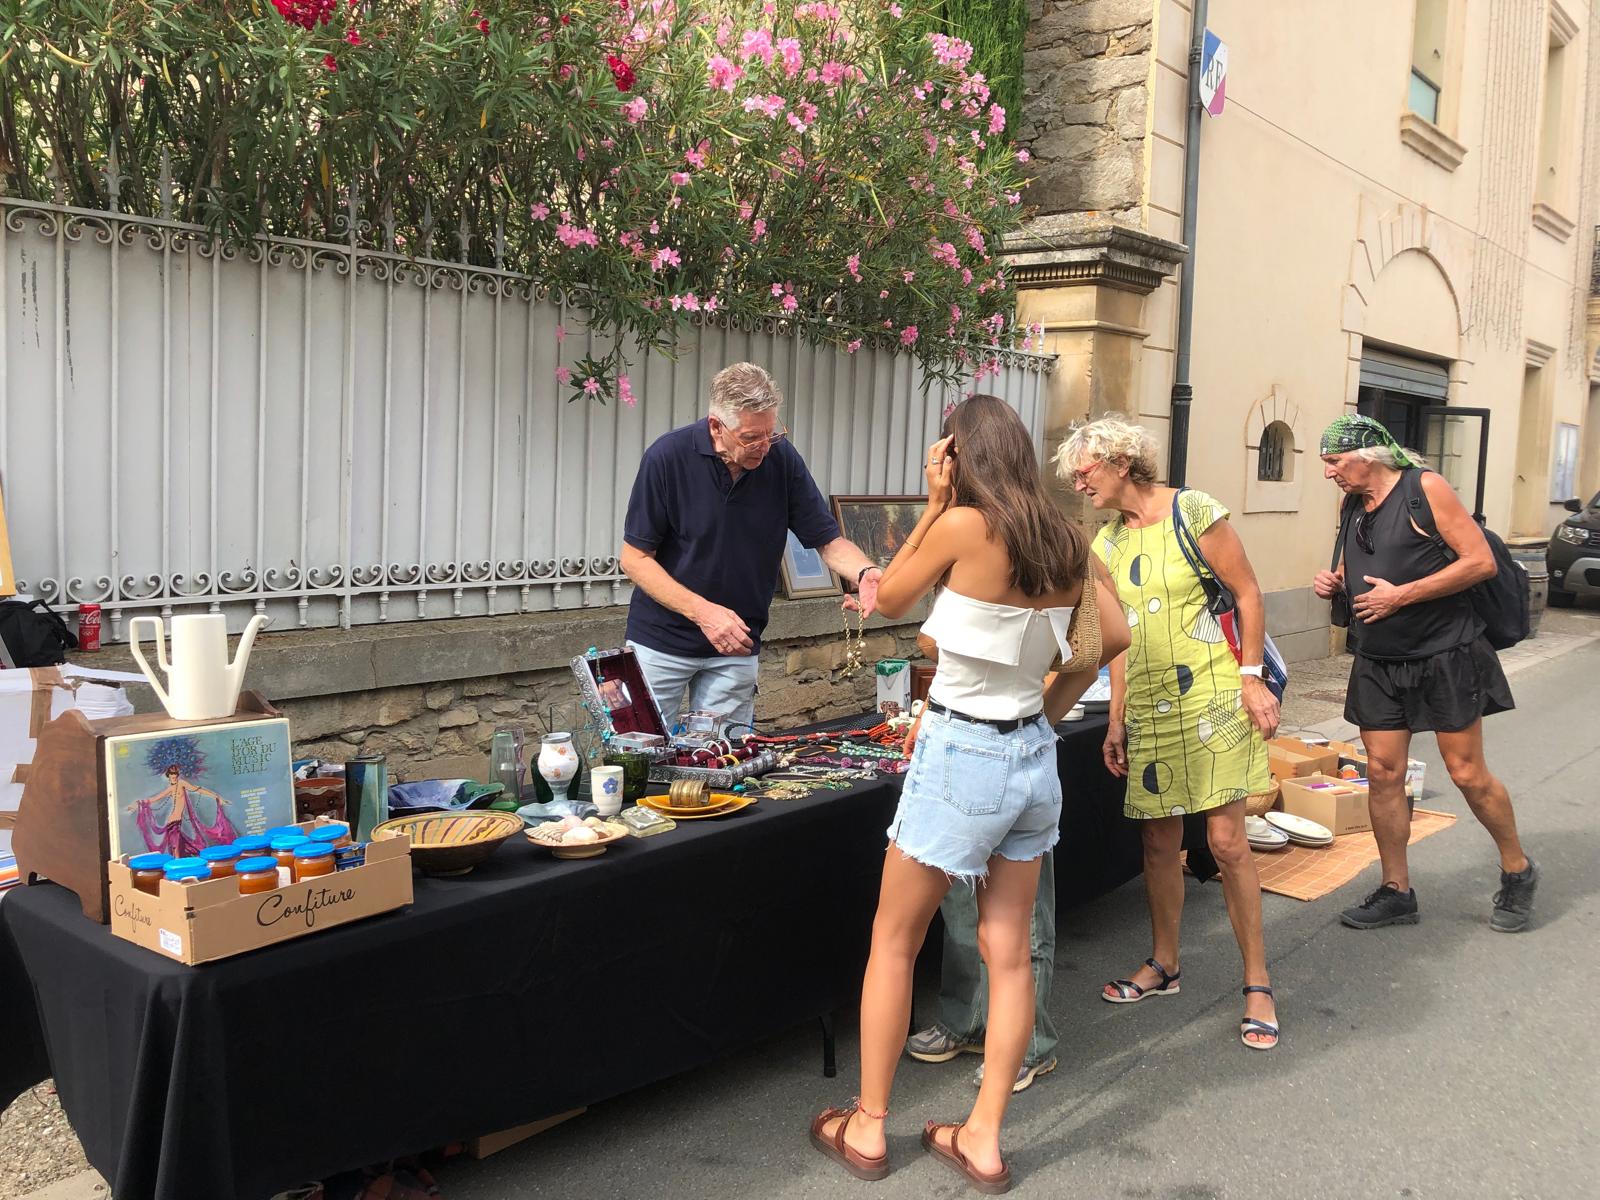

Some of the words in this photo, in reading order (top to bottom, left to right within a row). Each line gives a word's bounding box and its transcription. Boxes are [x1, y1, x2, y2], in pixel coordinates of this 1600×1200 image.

[1205, 53, 1223, 93] RF
[232, 736, 262, 749] L'AGE
[261, 743, 276, 753] DU
[232, 753, 272, 767] MUSIC
[232, 763, 269, 775] HALL
[114, 894, 152, 934] Confiture
[256, 888, 356, 928] Confiture
